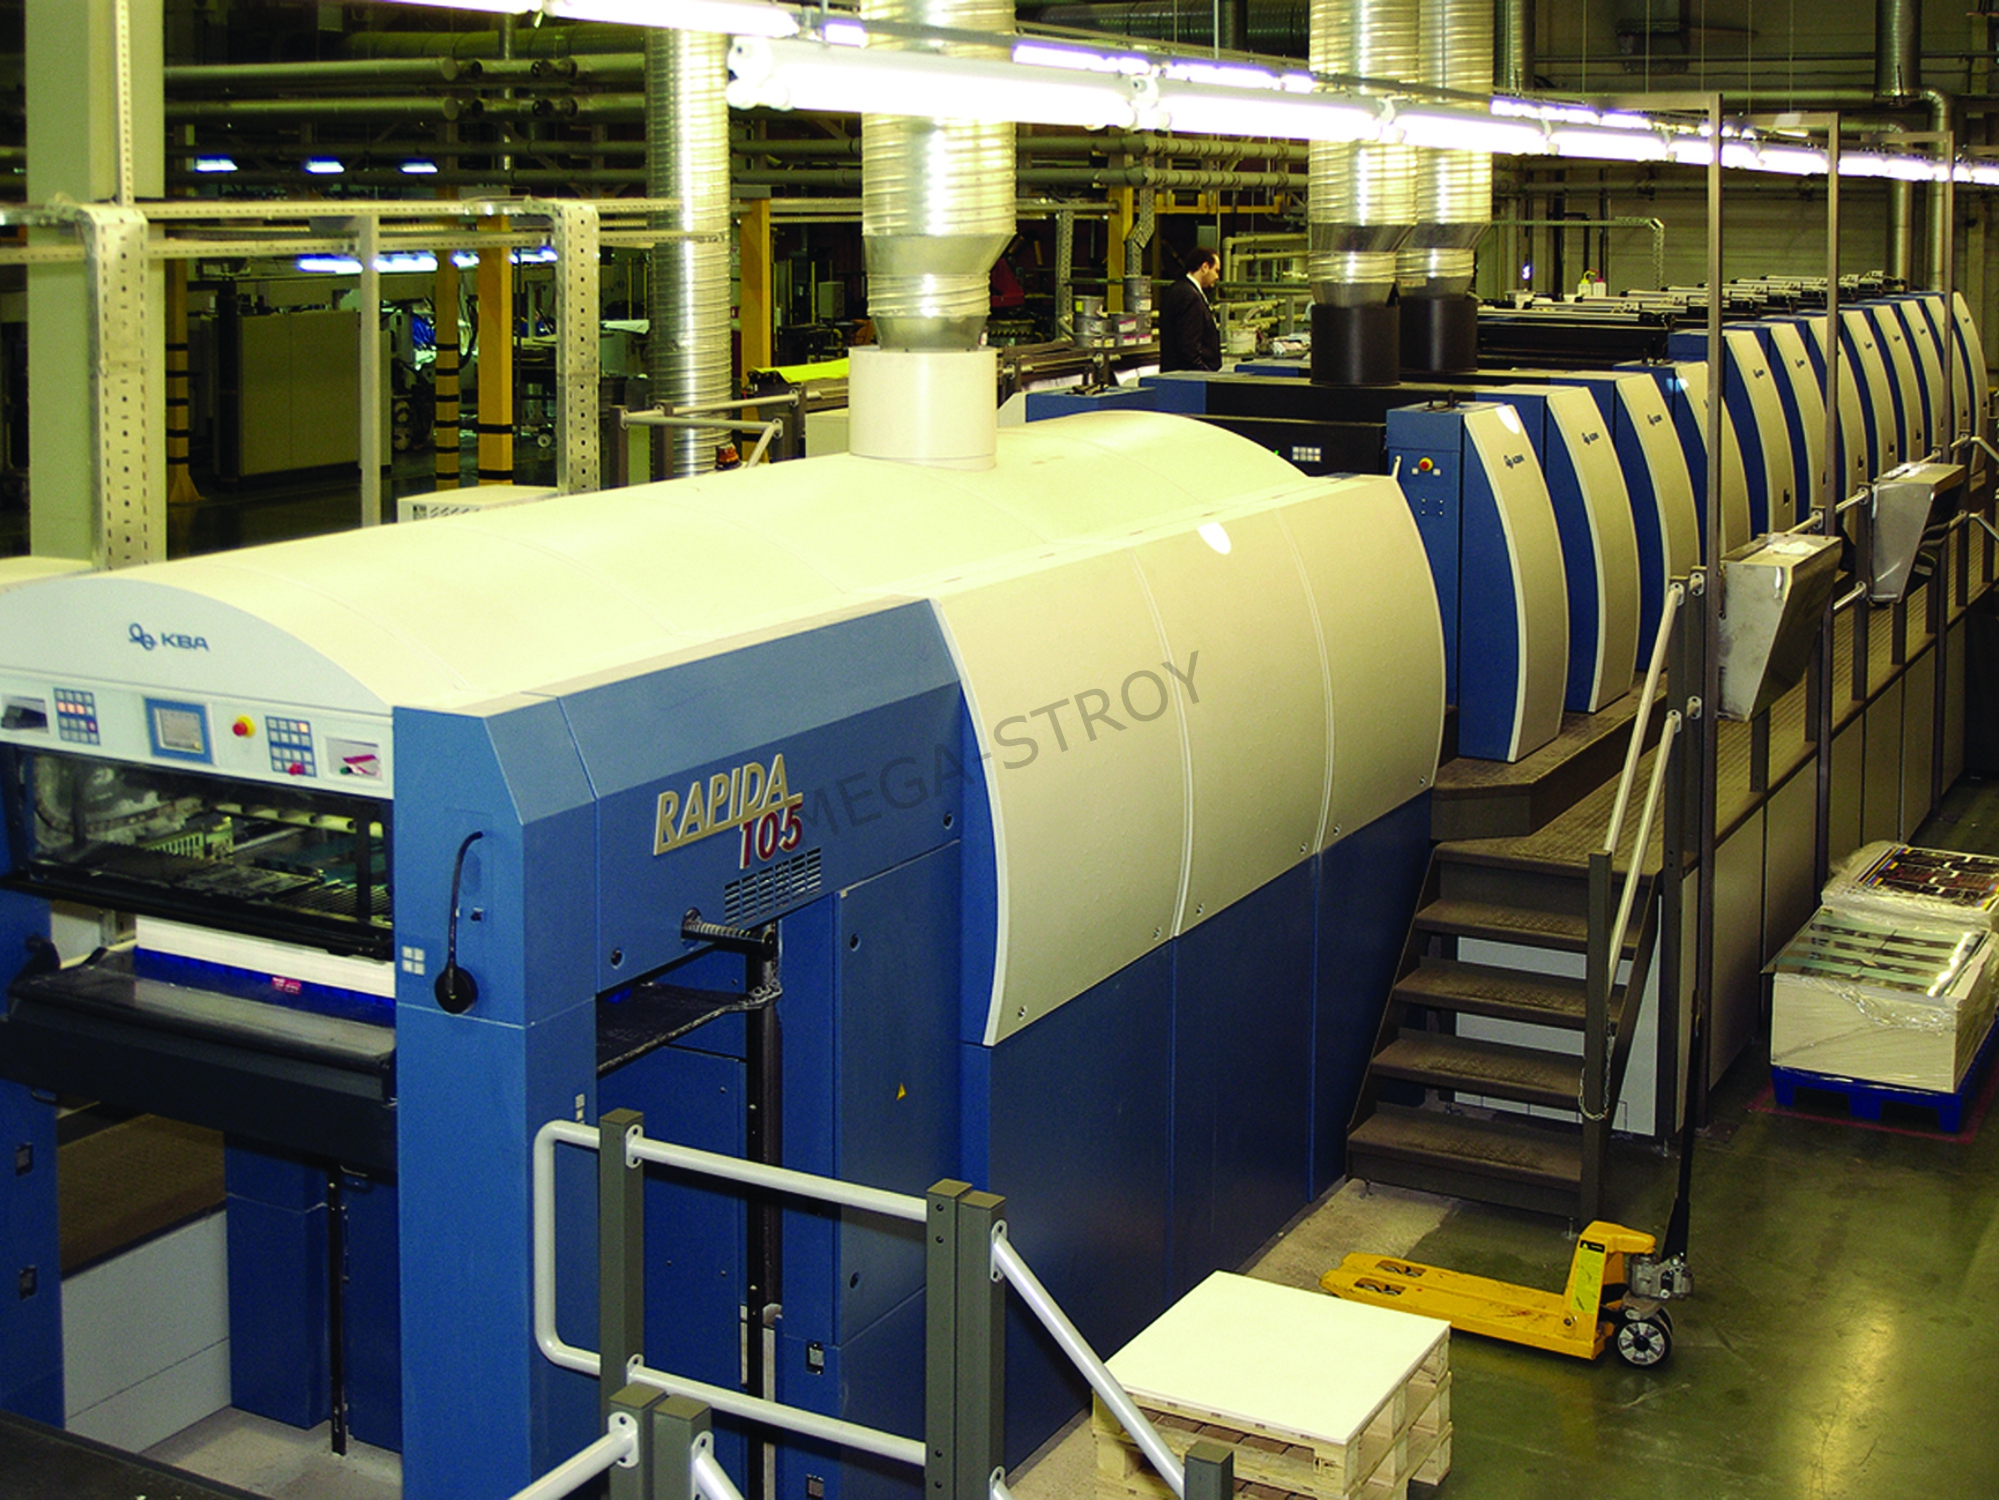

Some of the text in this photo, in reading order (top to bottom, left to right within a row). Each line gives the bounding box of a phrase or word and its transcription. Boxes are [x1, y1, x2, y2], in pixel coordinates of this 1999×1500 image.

[161, 632, 210, 652] KBA
[653, 753, 803, 856] RAPIDA
[739, 802, 803, 870] 105
